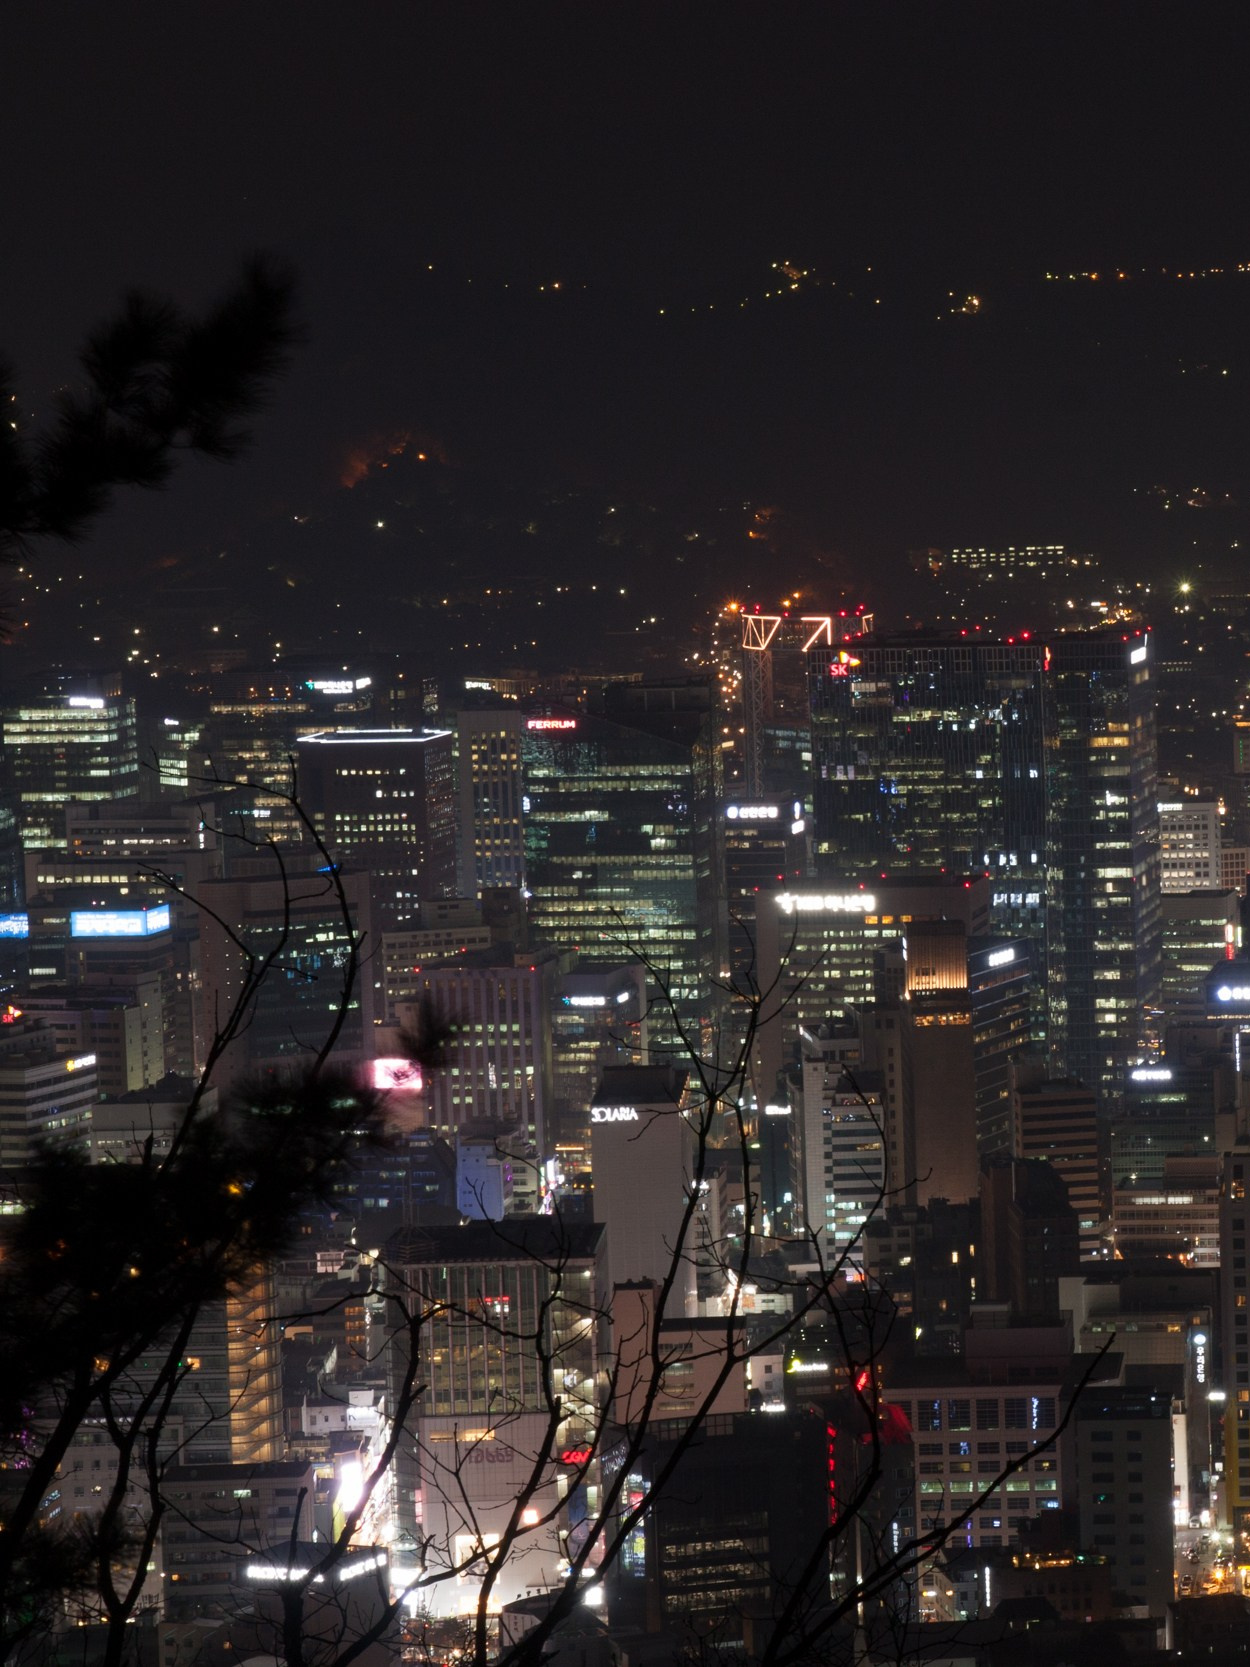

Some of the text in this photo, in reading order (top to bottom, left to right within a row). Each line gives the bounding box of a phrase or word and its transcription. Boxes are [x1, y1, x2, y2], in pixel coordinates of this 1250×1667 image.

[830, 663, 848, 676] SK
[528, 719, 577, 730] FERRUM
[3, 1013, 14, 1023] SK
[590, 1107, 639, 1122] SOLARIA
[1196, 1346, 1206, 1383] 우리은행
[562, 1450, 587, 1464] CGV
